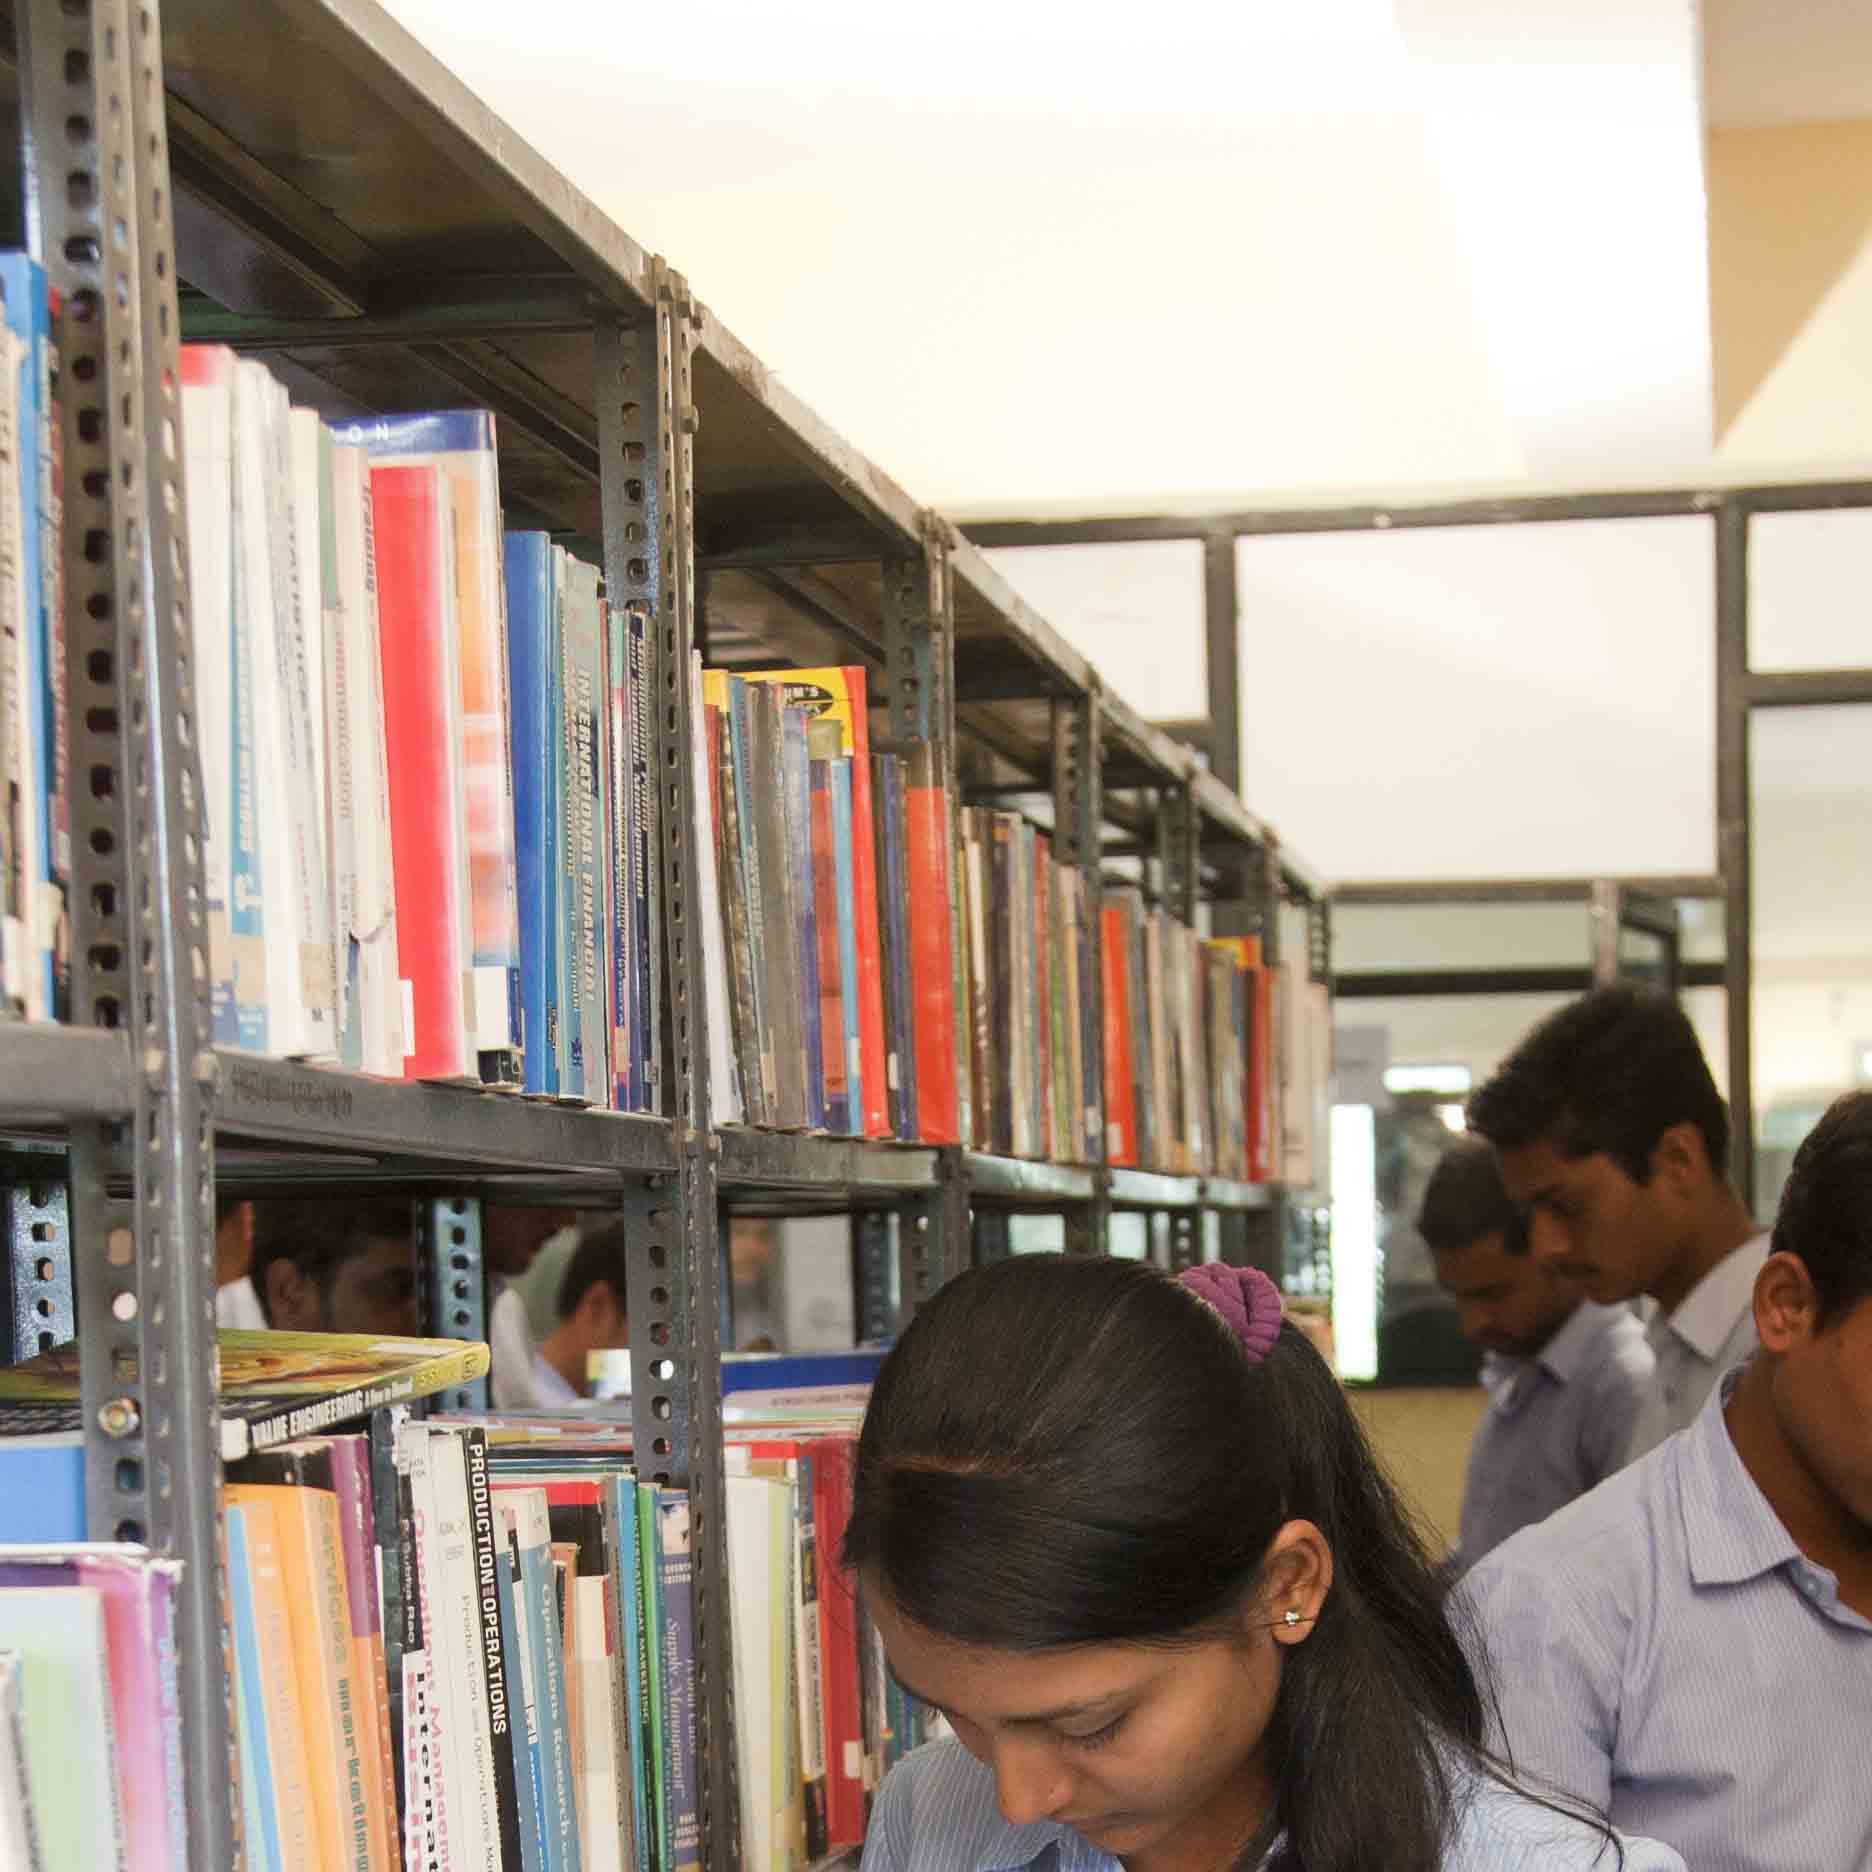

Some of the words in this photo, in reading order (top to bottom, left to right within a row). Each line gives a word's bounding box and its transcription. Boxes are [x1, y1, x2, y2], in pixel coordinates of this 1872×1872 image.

[577, 669, 594, 866] INTERNATIONAL
[251, 1415, 289, 1450] VALUE
[289, 1388, 365, 1436] ENGINEERING
[404, 1605, 416, 1645] Rao
[468, 1443, 496, 1585] PRODUCTION
[482, 1599, 508, 1735] OPERATIONS
[637, 1636, 650, 1727] MARKETING
[461, 1593, 479, 1703] Production
[474, 1735, 492, 1842] Operations
[541, 1582, 561, 1721] Operations
[552, 1727, 572, 1838] Research
